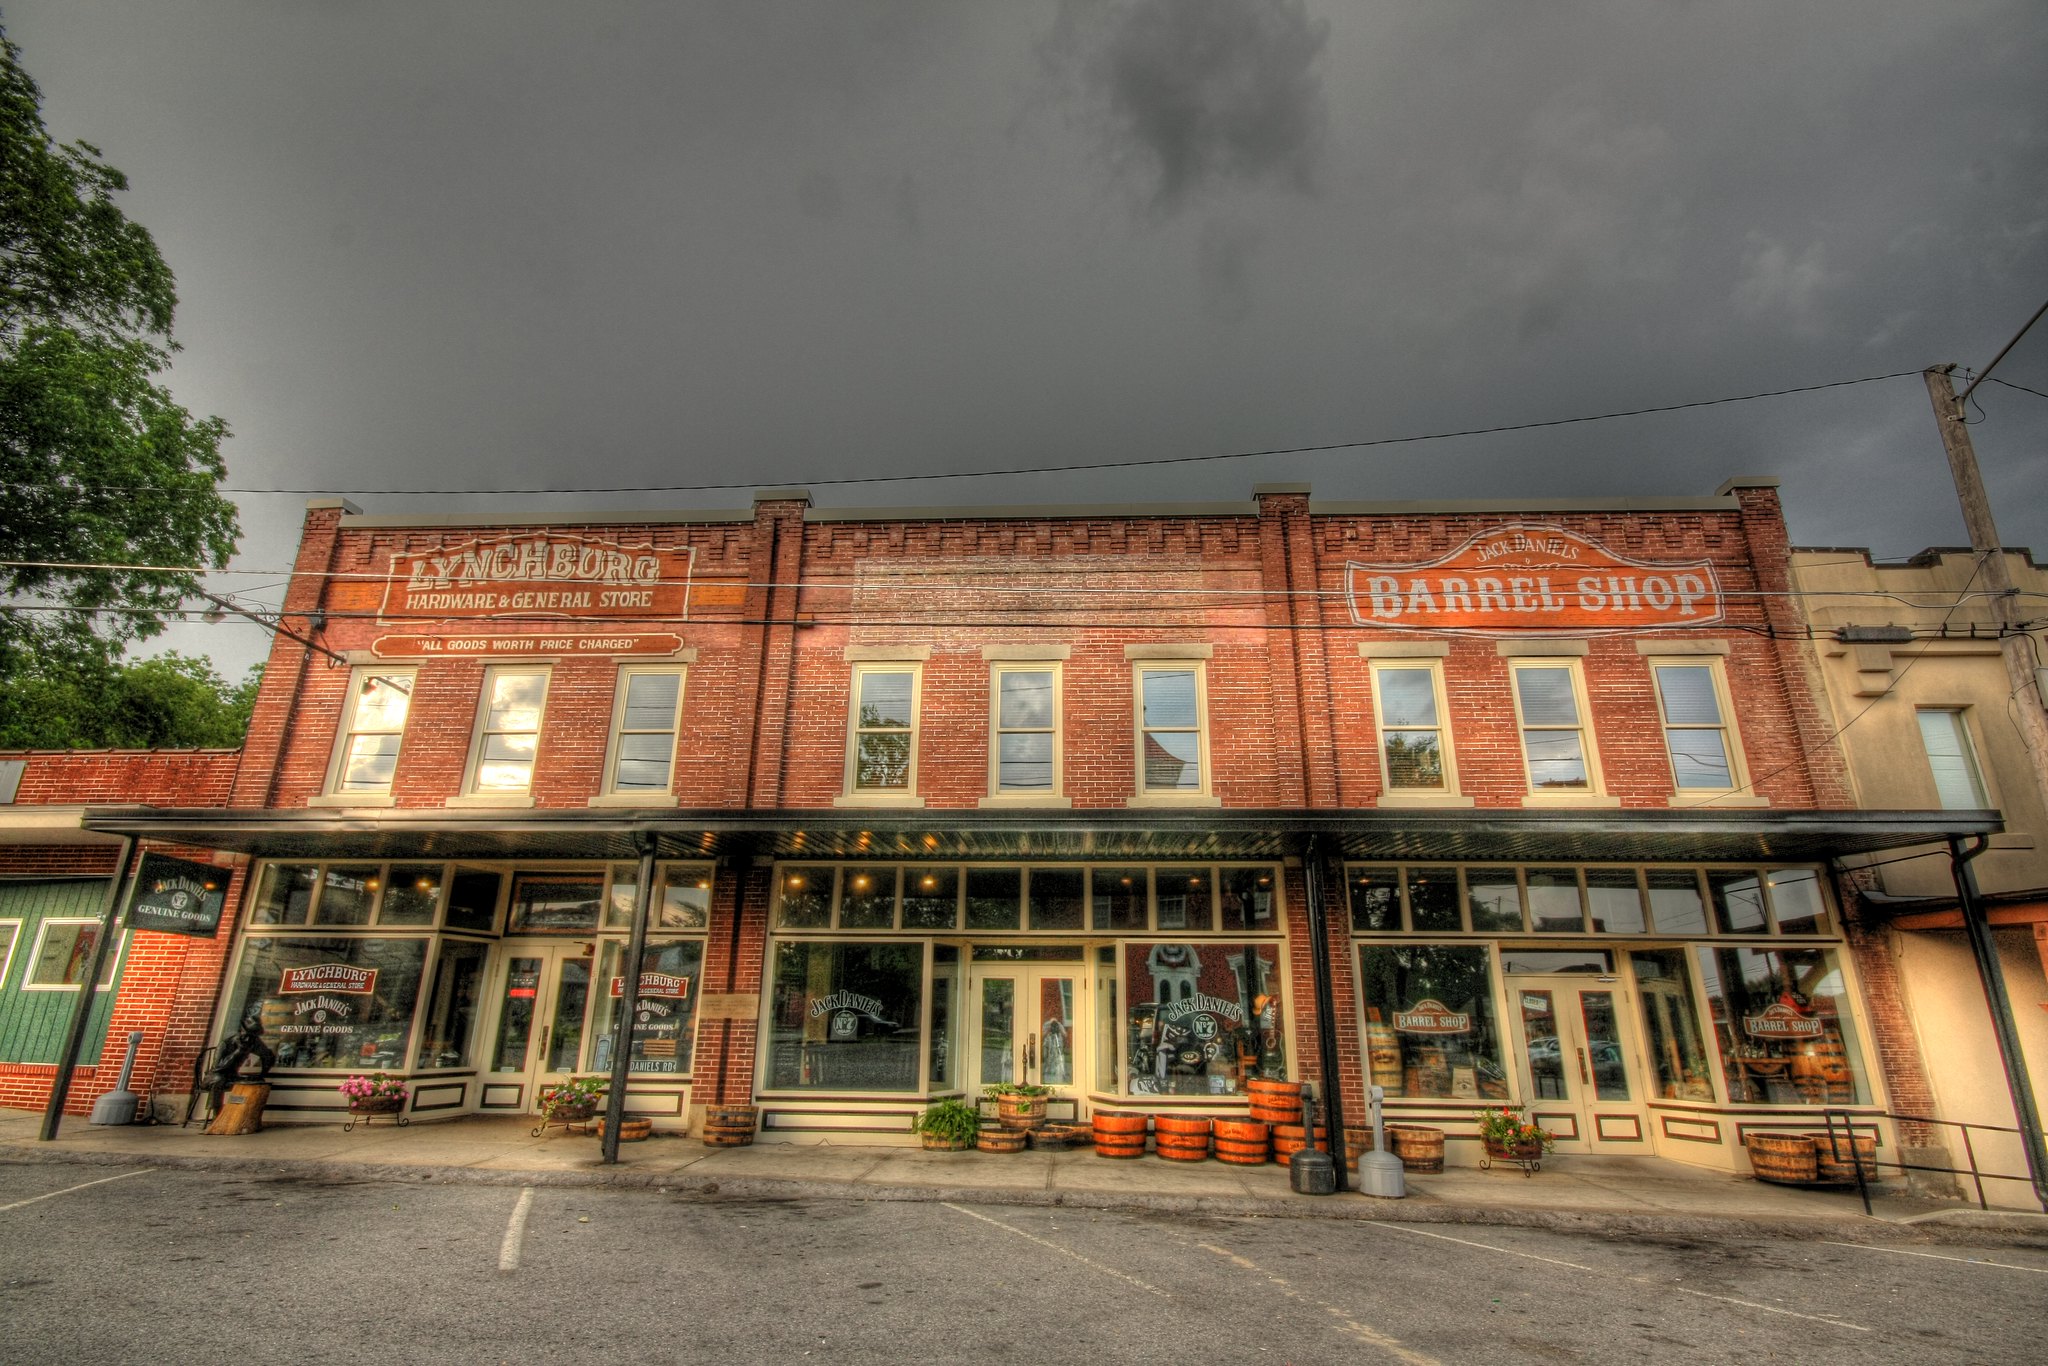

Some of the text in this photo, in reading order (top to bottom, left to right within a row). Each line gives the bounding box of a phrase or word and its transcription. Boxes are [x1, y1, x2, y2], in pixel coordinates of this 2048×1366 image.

[1477, 540, 1514, 562] JACK
[406, 540, 660, 590] LYNCHBURG
[406, 591, 653, 610] HARDWARE & GENERAL STORE
[1366, 573, 1705, 619] BARREL SHOP
[447, 640, 487, 650] GOODS
[493, 640, 533, 650] WORTH
[540, 639, 573, 650] PRICE
[155, 879, 178, 894] JACK
[138, 904, 211, 922] GENUINE GOODS
[292, 966, 367, 981] LYNCHBURG
[617, 975, 680, 988] LCHBURG
[294, 999, 317, 1016] JACK
[811, 994, 839, 1018] JACK
[1167, 998, 1197, 1022] JACK
[280, 1025, 354, 1034] GENUINE GOODS
[613, 1023, 648, 1031] GINE
[1398, 1015, 1467, 1030] BARREL SHOP
[1749, 1020, 1819, 1034] BARREL SHOP
[629, 1061, 673, 1072] DANIELS RD
